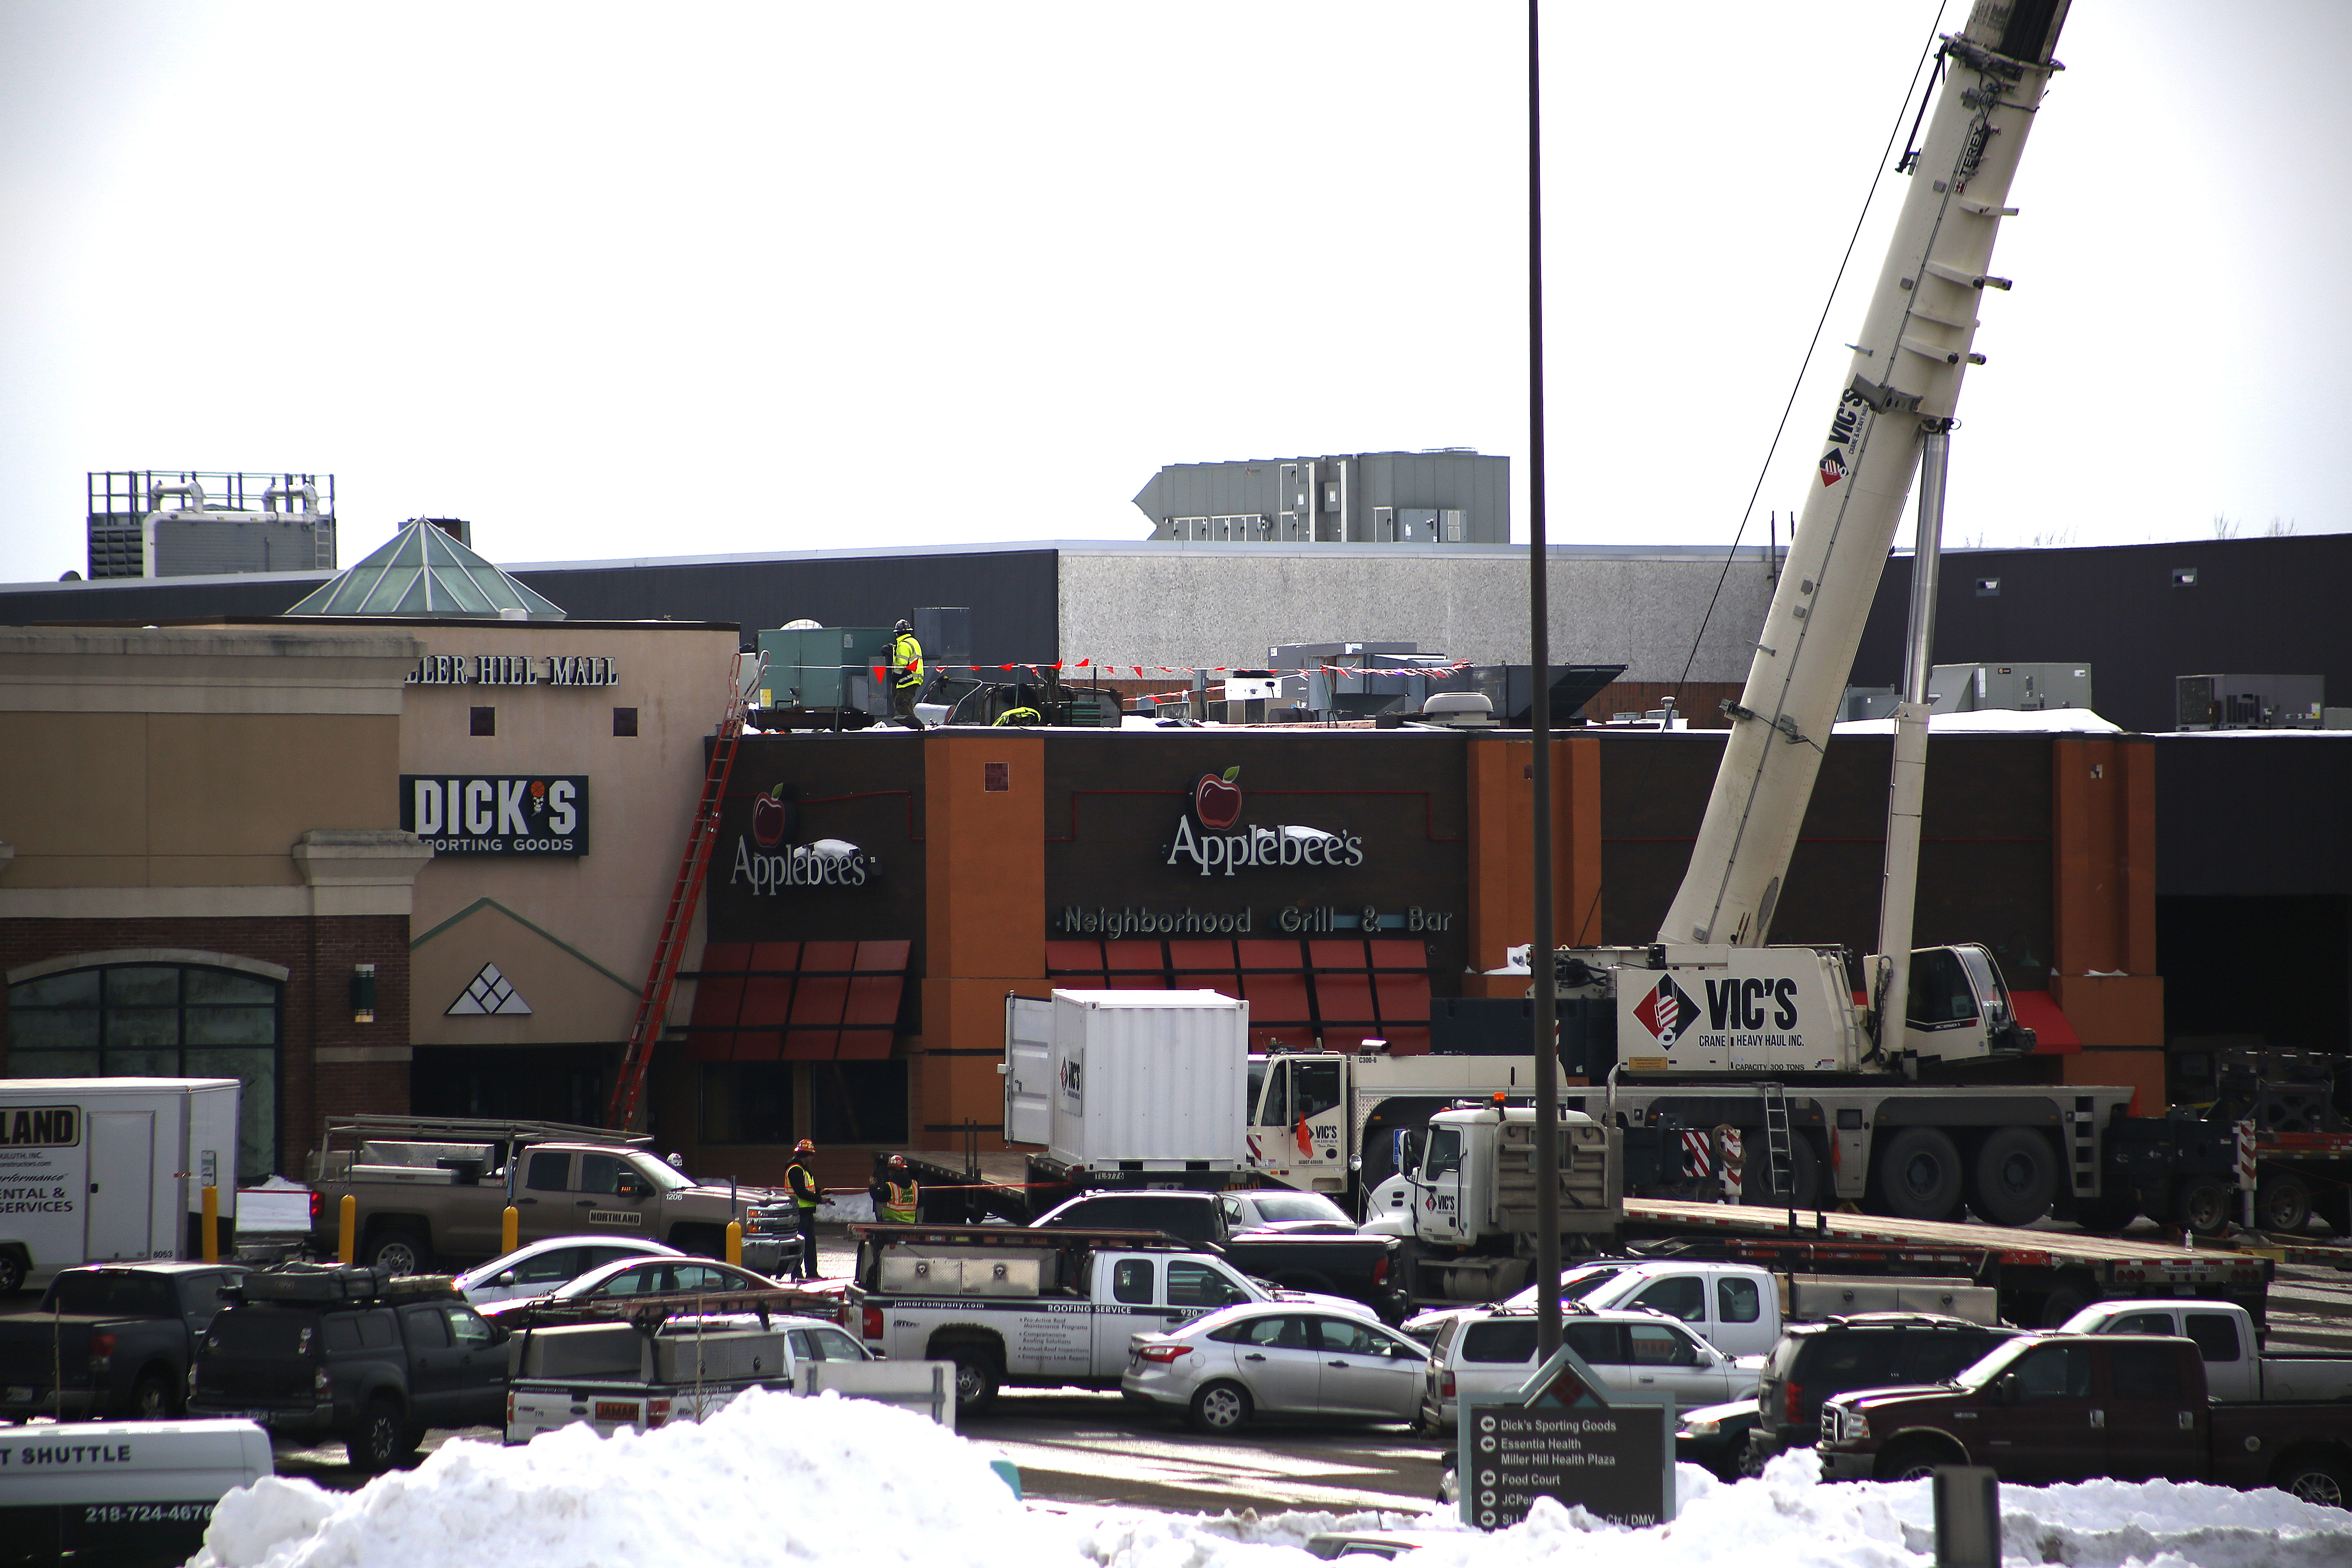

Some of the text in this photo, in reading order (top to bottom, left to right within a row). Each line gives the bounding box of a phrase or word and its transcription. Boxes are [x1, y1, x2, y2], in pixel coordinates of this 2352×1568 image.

[1829, 389, 1863, 444] VIC'S
[475, 656, 538, 685] HILL
[547, 656, 619, 686] MALL
[415, 780, 576, 835] DICK'S
[513, 839, 573, 851] GOODS
[1167, 814, 1363, 875] Applebee's
[1065, 905, 1452, 939] Neighborhood Grill & Bar
[1705, 978, 1798, 1031] VIC'S
[1699, 1034, 1804, 1047] CRANE HEAVY HAUL INC.
[1068, 1060, 1080, 1091] VIC'S
[1315, 1125, 1337, 1139] VIC'S
[0, 1187, 65, 1200] NTAL &
[1438, 1195, 1455, 1210] VIC'S
[590, 1212, 640, 1224] NORTHLAND
[893, 1300, 984, 1310] jamarcompany.com
[1095, 1306, 1131, 1314] SERVICE
[1501, 1419, 1617, 1434] Dick's Sporting Goods
[1501, 1437, 1581, 1450] Essentia Health
[22, 1445, 131, 1466] SHUTTLE
[1501, 1453, 1616, 1466] Miller Hill Health Plaza
[1502, 1472, 1561, 1486] Food Court
[1606, 1514, 1623, 1525] Ctr
[1624, 1514, 1628, 1526] /
[1631, 1514, 1655, 1526] DMV
